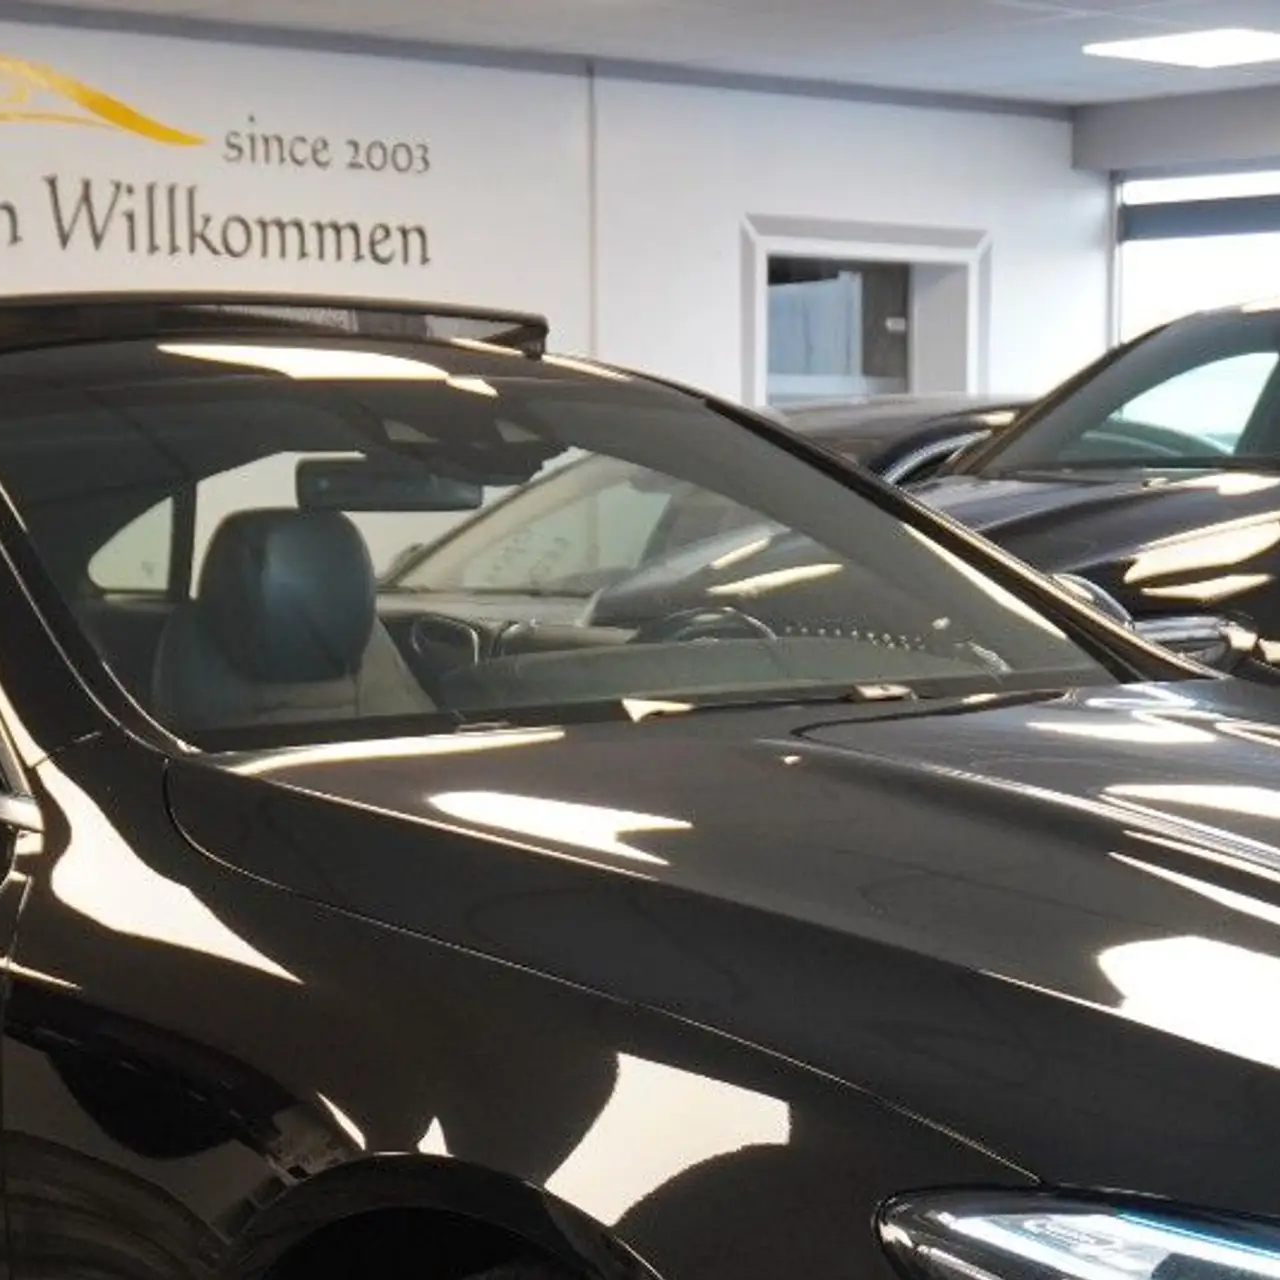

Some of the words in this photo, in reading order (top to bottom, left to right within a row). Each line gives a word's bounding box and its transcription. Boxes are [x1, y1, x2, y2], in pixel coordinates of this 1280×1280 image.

[223, 115, 333, 170] since
[345, 138, 431, 174] 2003
[43, 175, 431, 266] Willkommen
